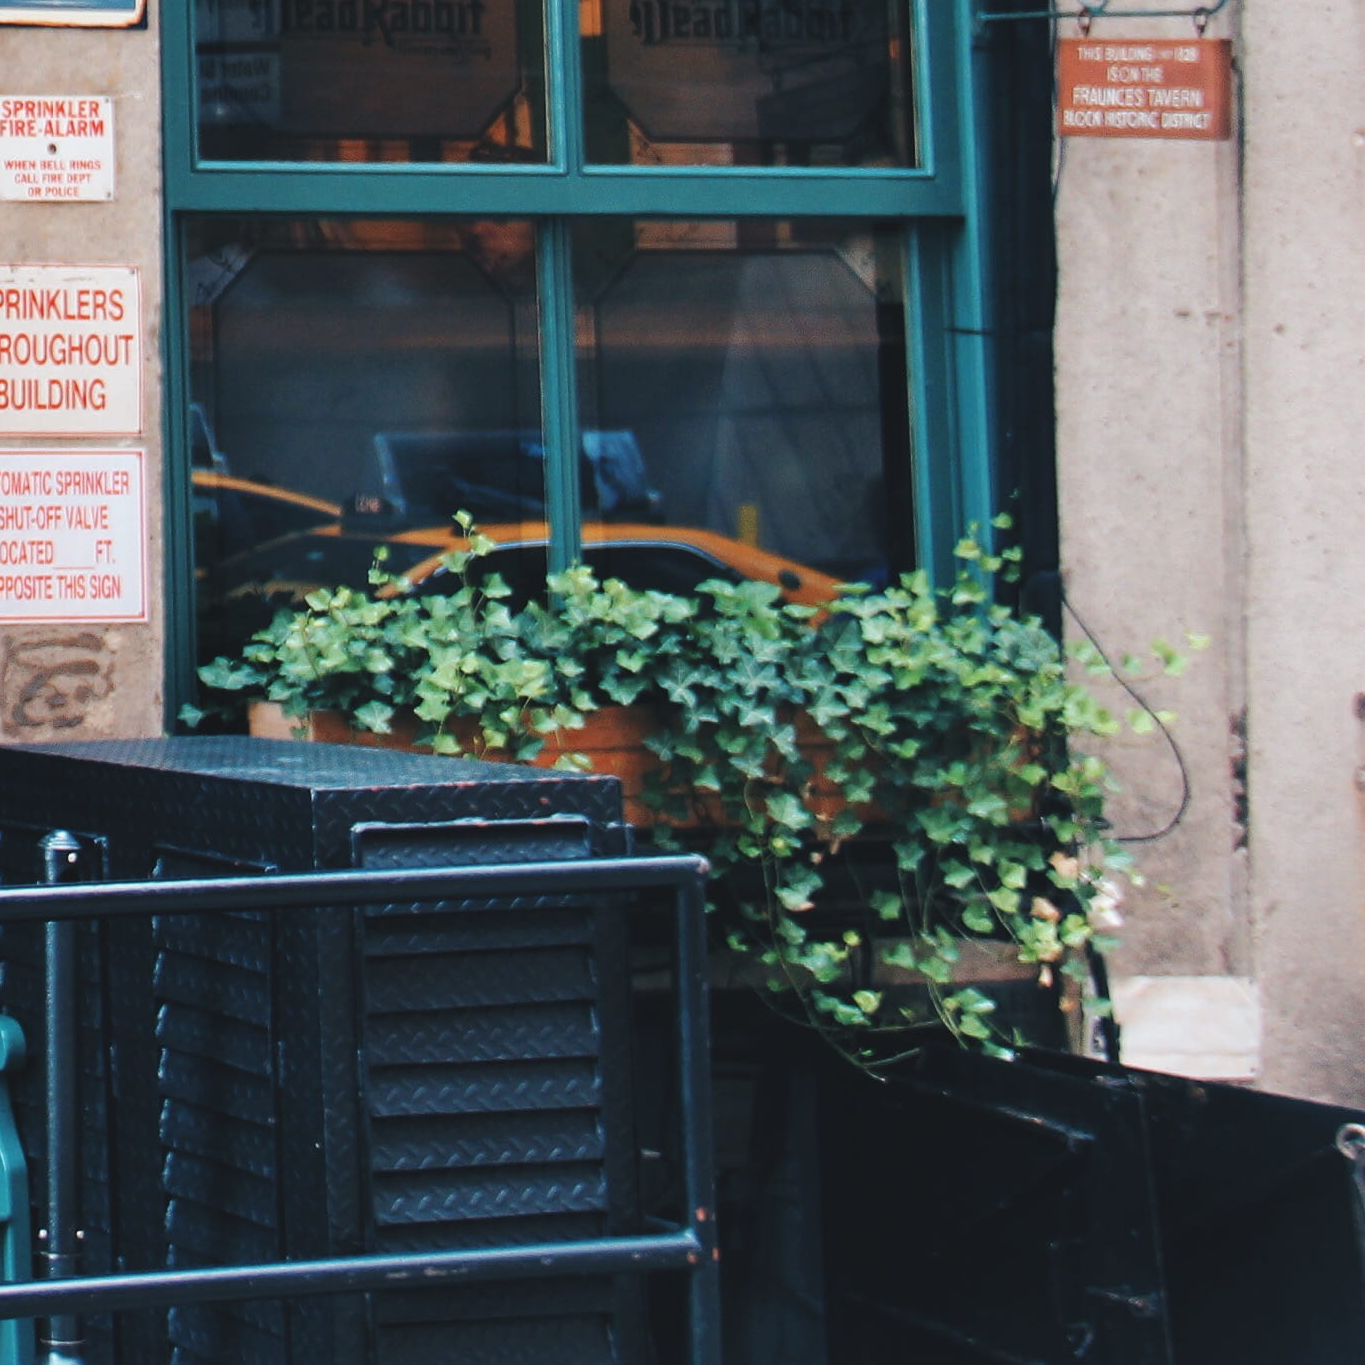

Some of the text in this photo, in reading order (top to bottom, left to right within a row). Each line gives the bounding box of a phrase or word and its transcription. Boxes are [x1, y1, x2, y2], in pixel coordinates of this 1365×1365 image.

[1, 100, 101, 119] SPRINKLER
[4, 160, 102, 171] WHEN BELL RINGS
[14, 174, 40, 185] CALL
[42, 174, 64, 185] FIRE
[27, 187, 80, 198] OR POLICE
[56, 471, 130, 496] SPRINKLER
[65, 506, 109, 530] VALVE
[96, 540, 116, 565] FT.
[57, 576, 86, 600] THIS
[89, 575, 121, 600] SIGN
